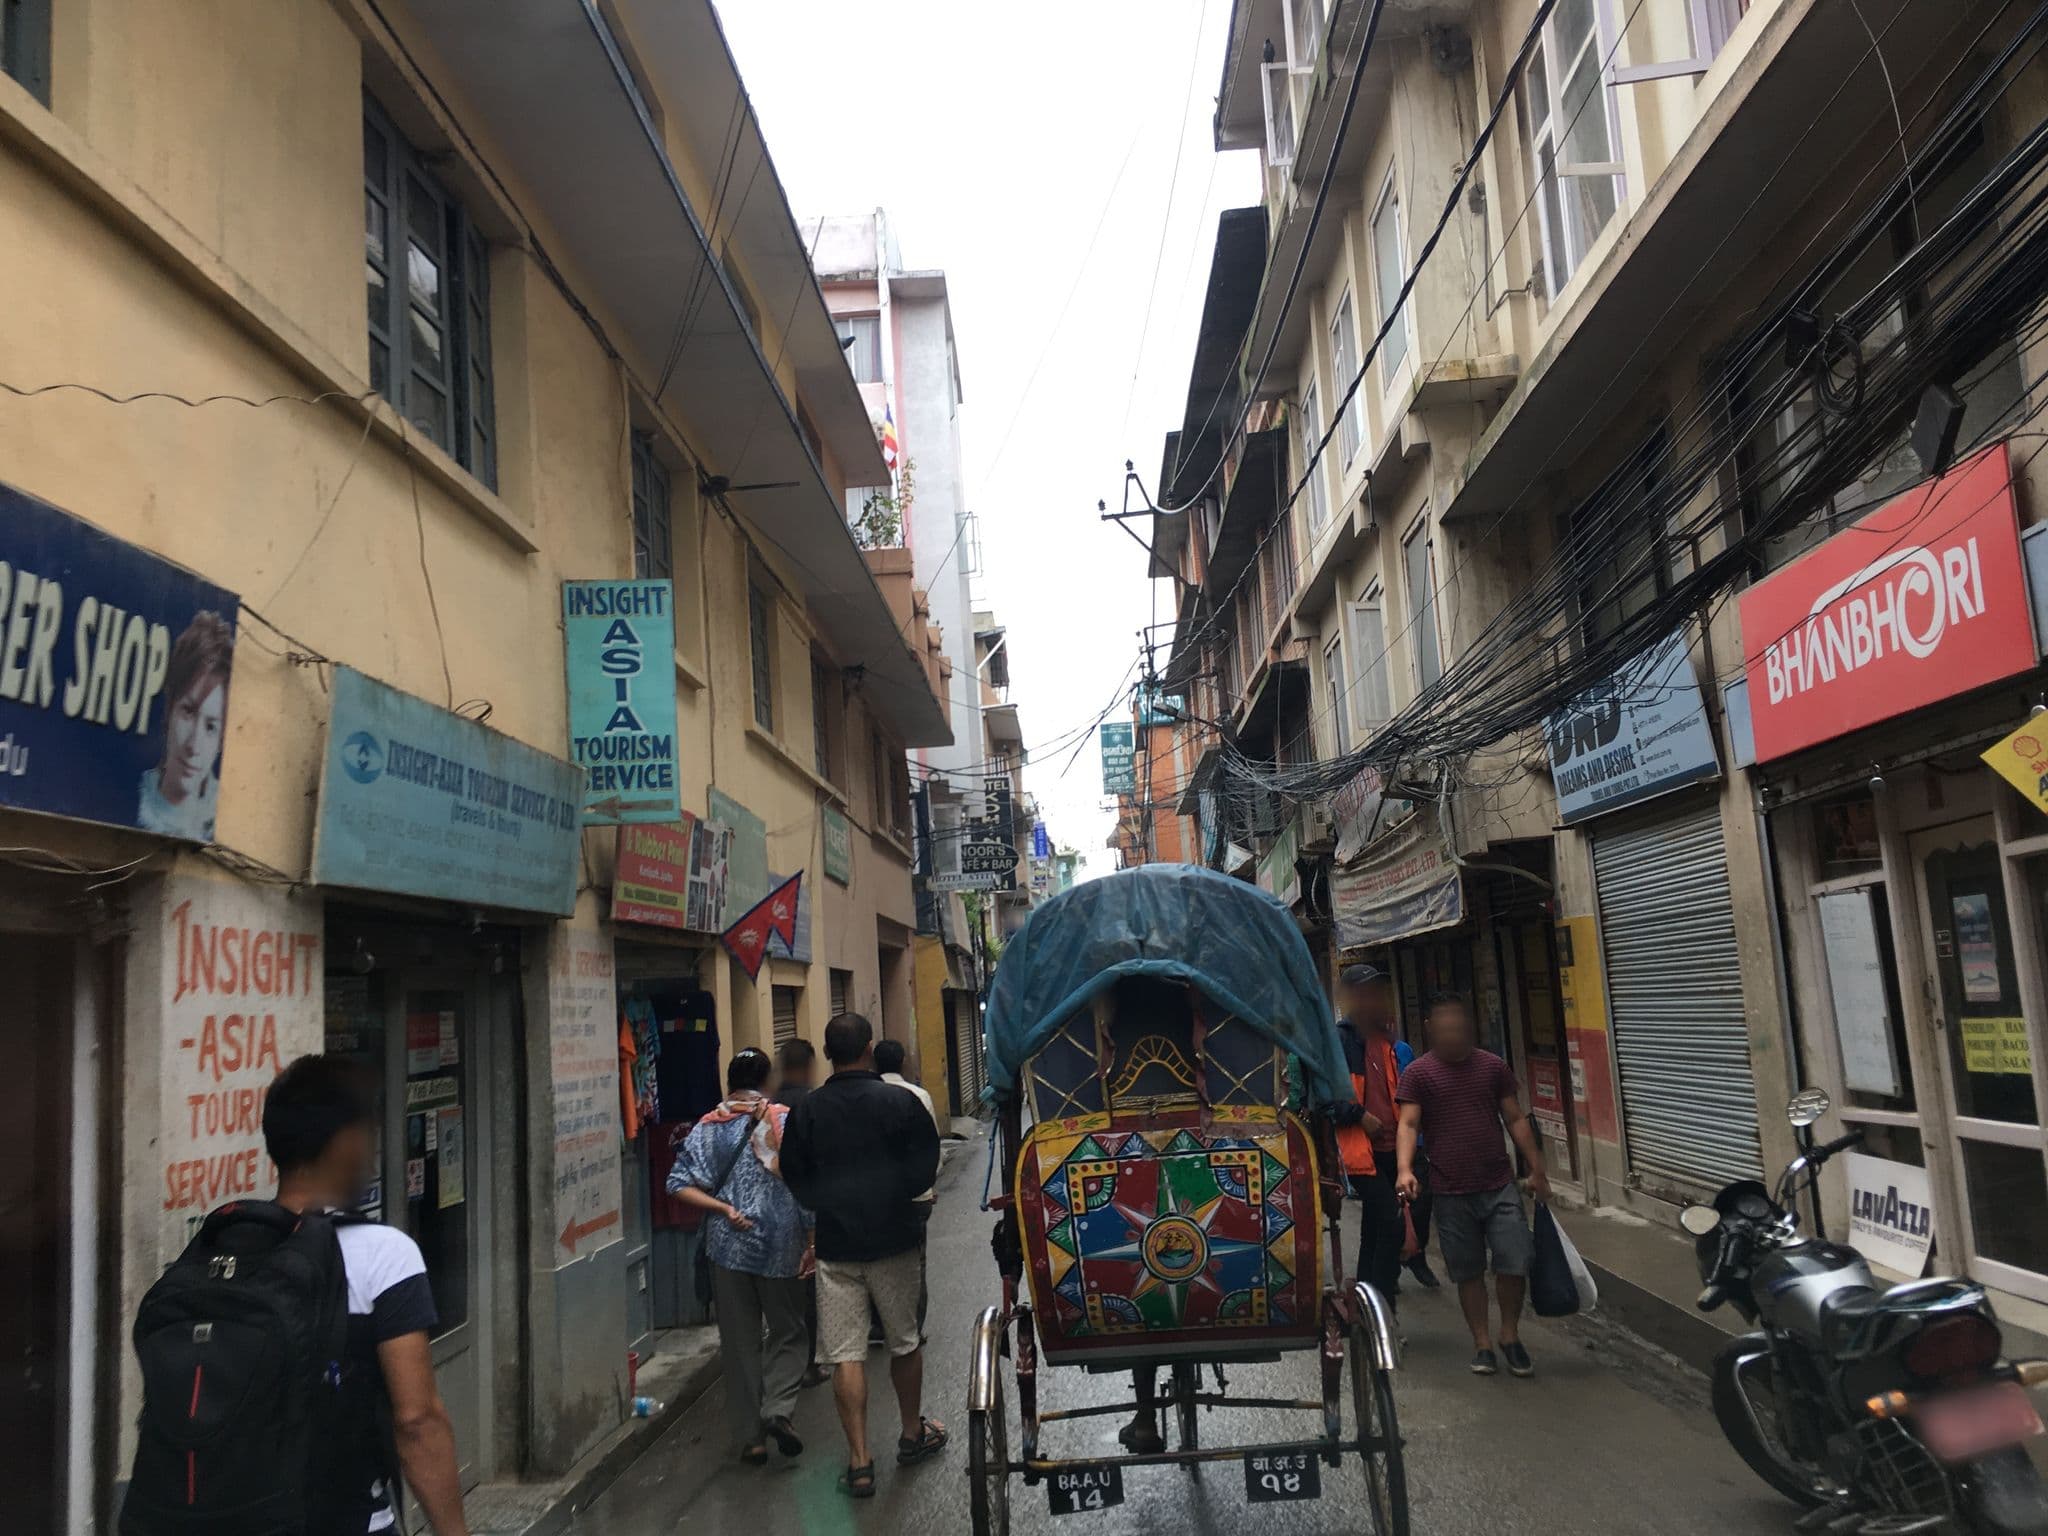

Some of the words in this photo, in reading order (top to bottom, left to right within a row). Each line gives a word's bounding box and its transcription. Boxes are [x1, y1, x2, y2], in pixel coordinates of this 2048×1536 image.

[568, 586, 668, 617] INSIGHT
[1765, 537, 1985, 704] BHANBHORI
[63, 596, 171, 735] SHOP
[601, 618, 642, 733] ASIA
[574, 735, 672, 761] TOURISM
[1587, 758, 1605, 786] AND
[1603, 744, 1637, 779] DESIRE
[585, 764, 673, 791] ERVICE
[992, 859, 1013, 869] BAR
[171, 900, 319, 1003] INSIGHT
[163, 1148, 260, 1212] SERVICE
[1853, 1186, 1930, 1238] LAVAZZA
[1070, 1489, 1104, 1511] 14
